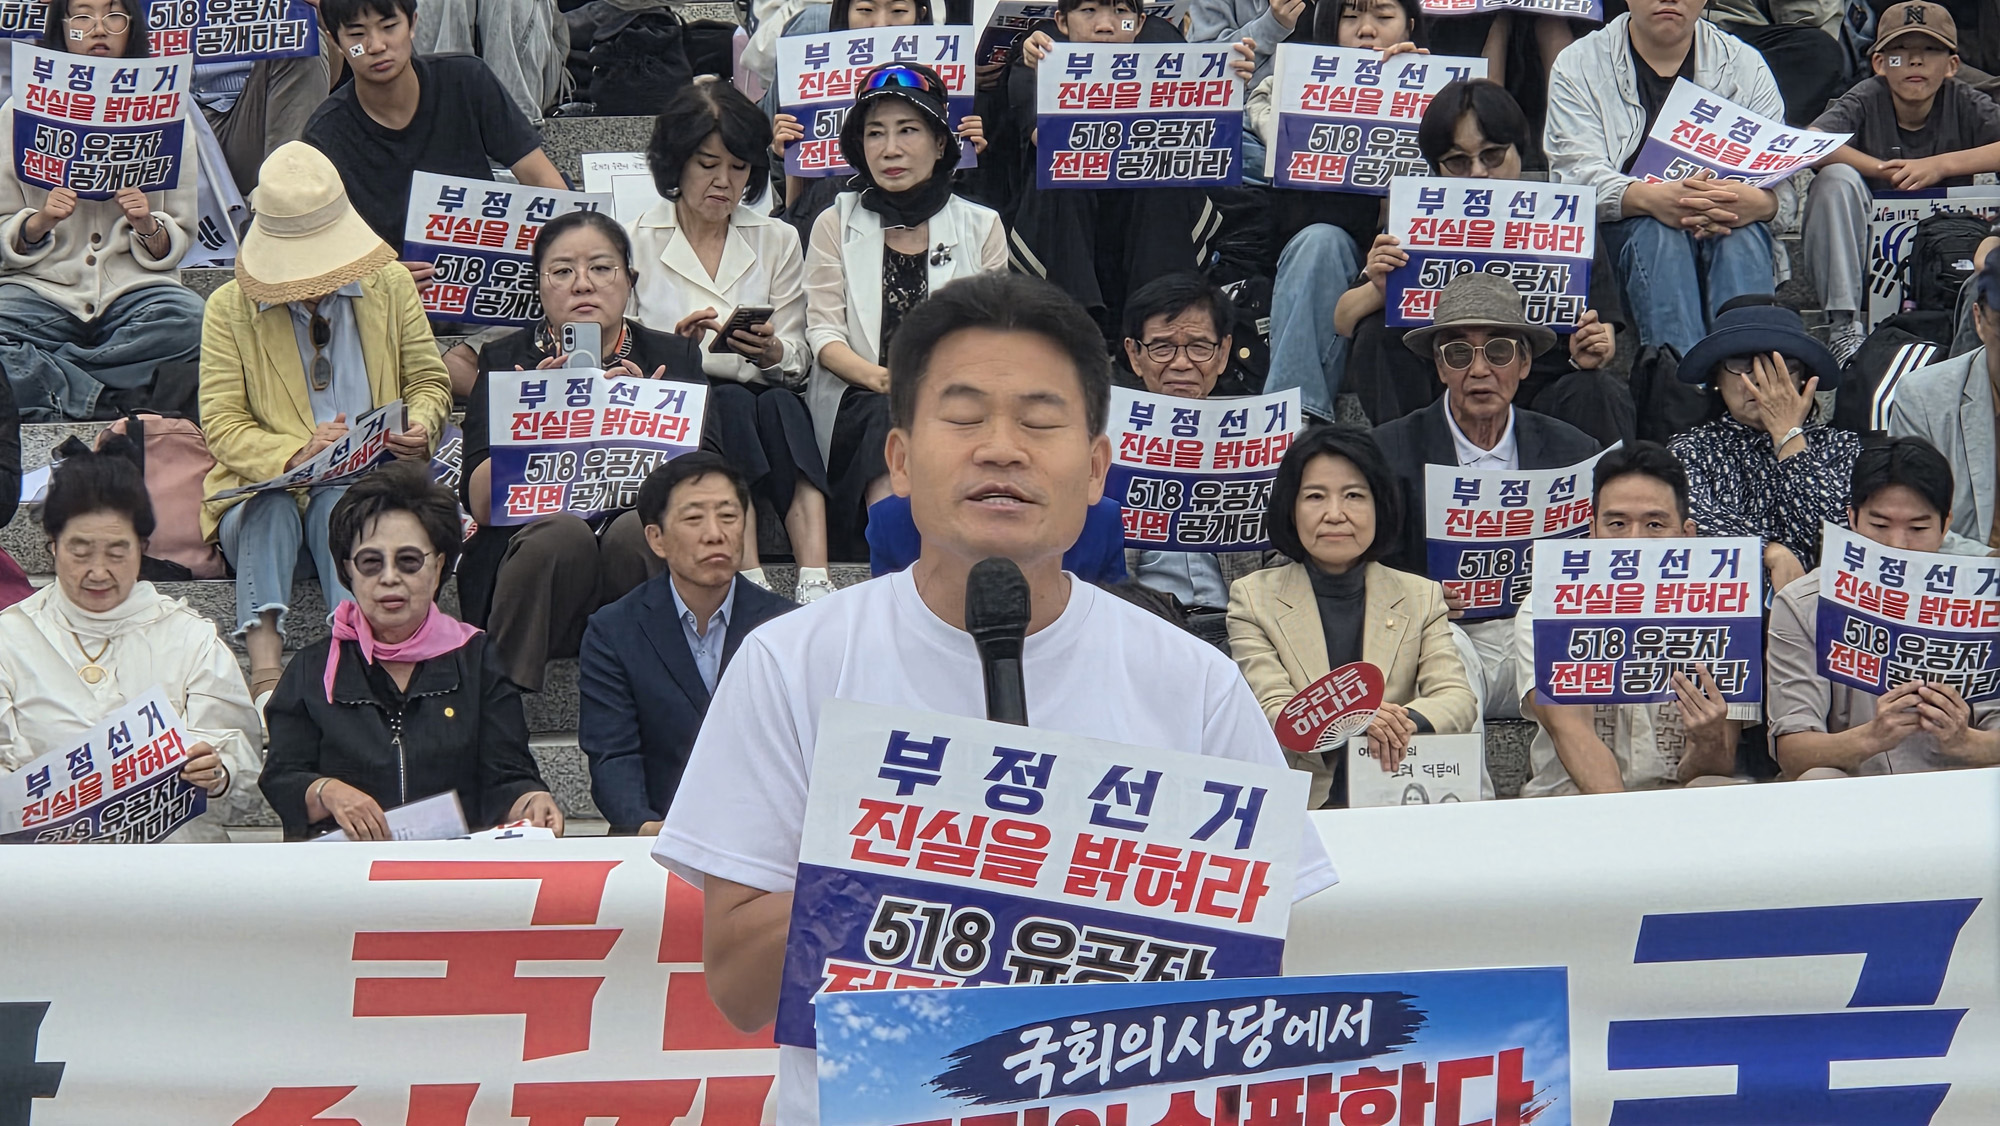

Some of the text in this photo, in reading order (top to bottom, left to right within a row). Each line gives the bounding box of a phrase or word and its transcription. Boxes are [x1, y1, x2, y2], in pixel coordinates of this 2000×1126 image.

[148, 1, 199, 29] 518
[196, 19, 308, 57] 공개하라
[804, 35, 960, 70] 부정선거
[33, 56, 179, 94] 부정선거
[1066, 53, 1228, 80] 부정선거
[26, 84, 180, 123] 진실을 밝혀라
[1058, 80, 1233, 109] 진실을 밝혀라
[1300, 84, 1384, 116] 진실을
[34, 123, 163, 163] 518 유공자
[1069, 118, 1216, 150] 518 유공자
[1308, 123, 1362, 153] 518
[1670, 120, 1752, 167] 진실을
[1689, 98, 1835, 154] 부정선거
[22, 149, 173, 192] 전면 공개하라
[1050, 148, 1232, 180] 전면 공개하라
[1288, 152, 1349, 184] 전면
[1417, 187, 1580, 222] 부정선거
[425, 214, 509, 248] 진실을
[1408, 217, 1585, 254] 진실을 밝혀라
[433, 253, 486, 284] 518
[519, 377, 687, 414] 부정선거
[511, 407, 690, 443] 진실을 밝혀라
[1128, 400, 1288, 438] 부정선거
[524, 450, 577, 484] 518
[1119, 432, 1204, 469] 진실을
[504, 483, 567, 517] 전면
[1126, 476, 1184, 511] 518
[1445, 507, 1535, 538] 진실을
[1458, 548, 1516, 580] 518
[1562, 548, 1741, 581] 부정선거
[1553, 583, 1645, 615] 진실을
[1654, 582, 1751, 614] 밝혀라
[1834, 570, 1910, 621] 진실을
[1568, 626, 1731, 661] 518 유공자
[1844, 615, 1992, 671] 518 유공자
[1549, 661, 1617, 696] 전면
[1827, 639, 1882, 686] 전면
[1284, 668, 1360, 719] 우리는
[1291, 680, 1368, 735] 하나다
[26, 701, 165, 798] 부정선거
[22, 727, 187, 828] 진실을 밝혀라
[878, 730, 1268, 851] 부정선거
[100, 771, 179, 833] 유공자
[849, 798, 1271, 923] 진실을 밝혀라
[863, 894, 996, 975] 518
[1002, 998, 1371, 1099] 국회의사당에서
